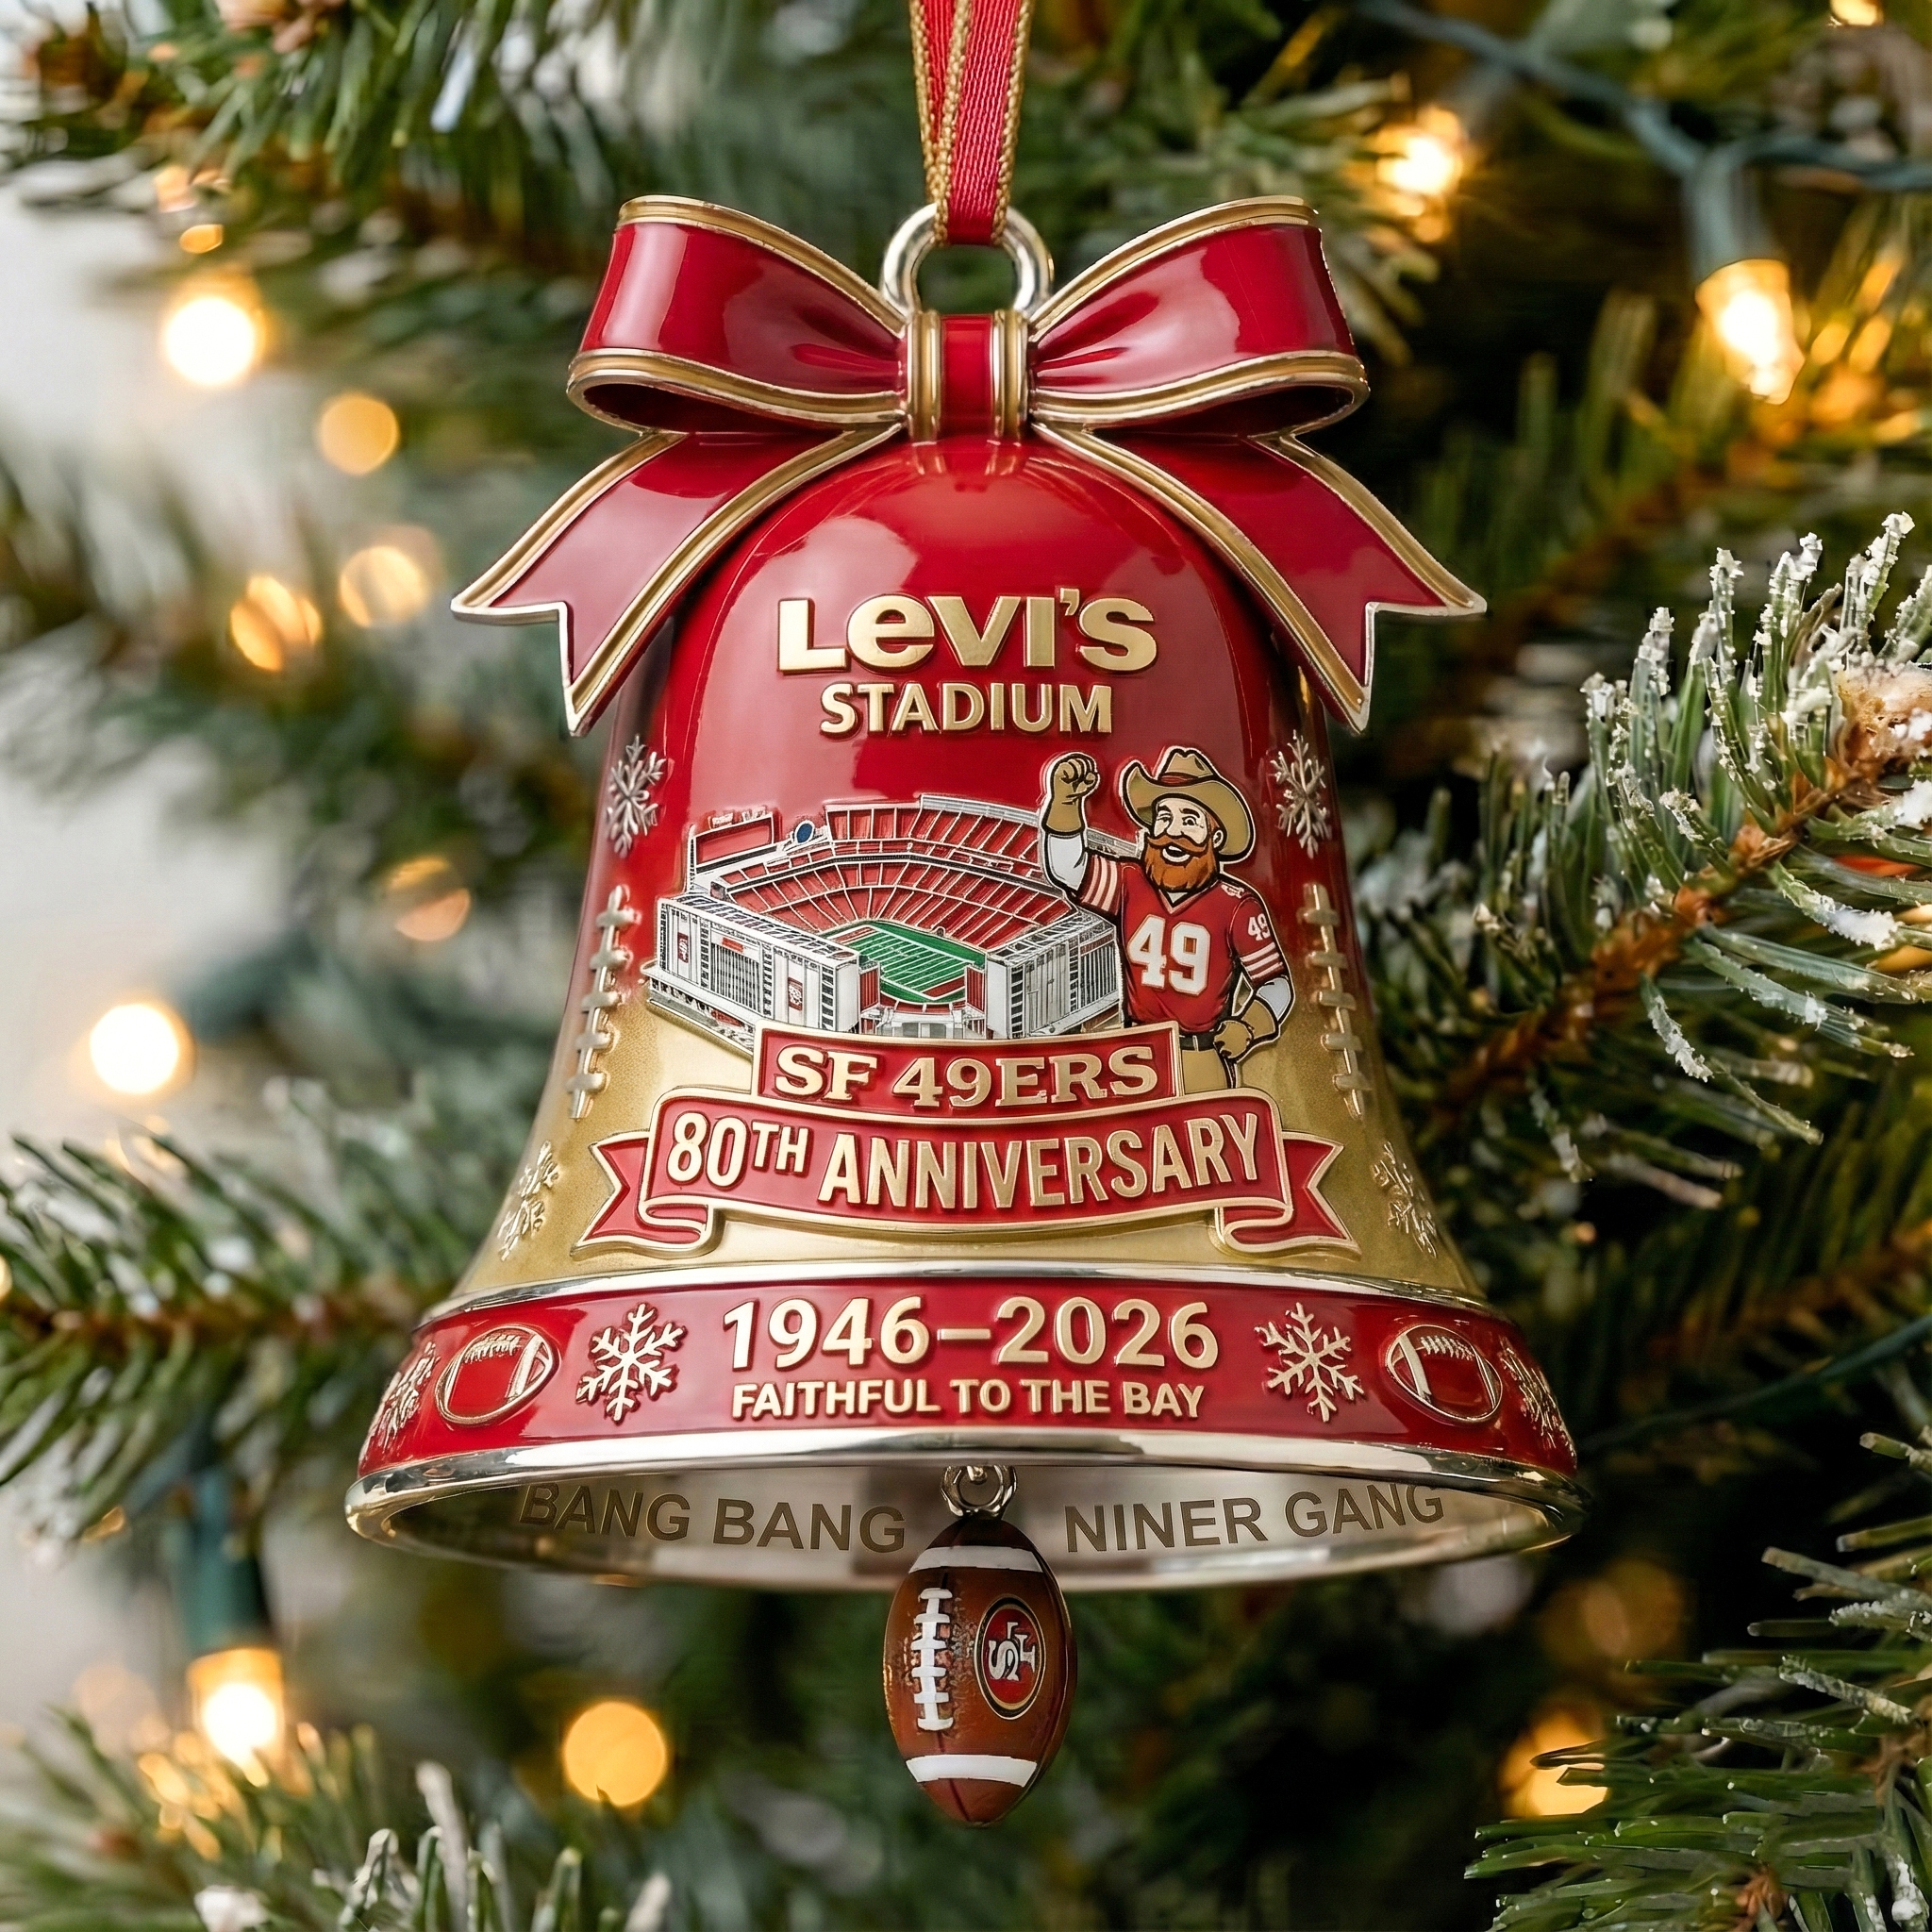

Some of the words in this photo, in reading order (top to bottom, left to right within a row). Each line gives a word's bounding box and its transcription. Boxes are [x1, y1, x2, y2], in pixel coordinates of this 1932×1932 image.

[821, 683, 1112, 734] STADIUM
[1128, 915, 1210, 995] 49
[1248, 913, 1271, 941] 49
[774, 1045, 877, 1100] SF
[892, 1047, 1159, 1108] 49ERS
[667, 1111, 808, 1187] 80TH
[818, 1113, 1258, 1208] ANNIVERSARY
[732, 1379, 941, 1418] FAITHFUL
[950, 1379, 1010, 1412] TO
[1020, 1379, 1110, 1414] THE
[1123, 1381, 1205, 1418] BAY
[519, 1482, 691, 1541] BANG
[712, 1498, 906, 1553] BANG
[1065, 1498, 1268, 1552] NINER
[1284, 1484, 1444, 1538] GANG
